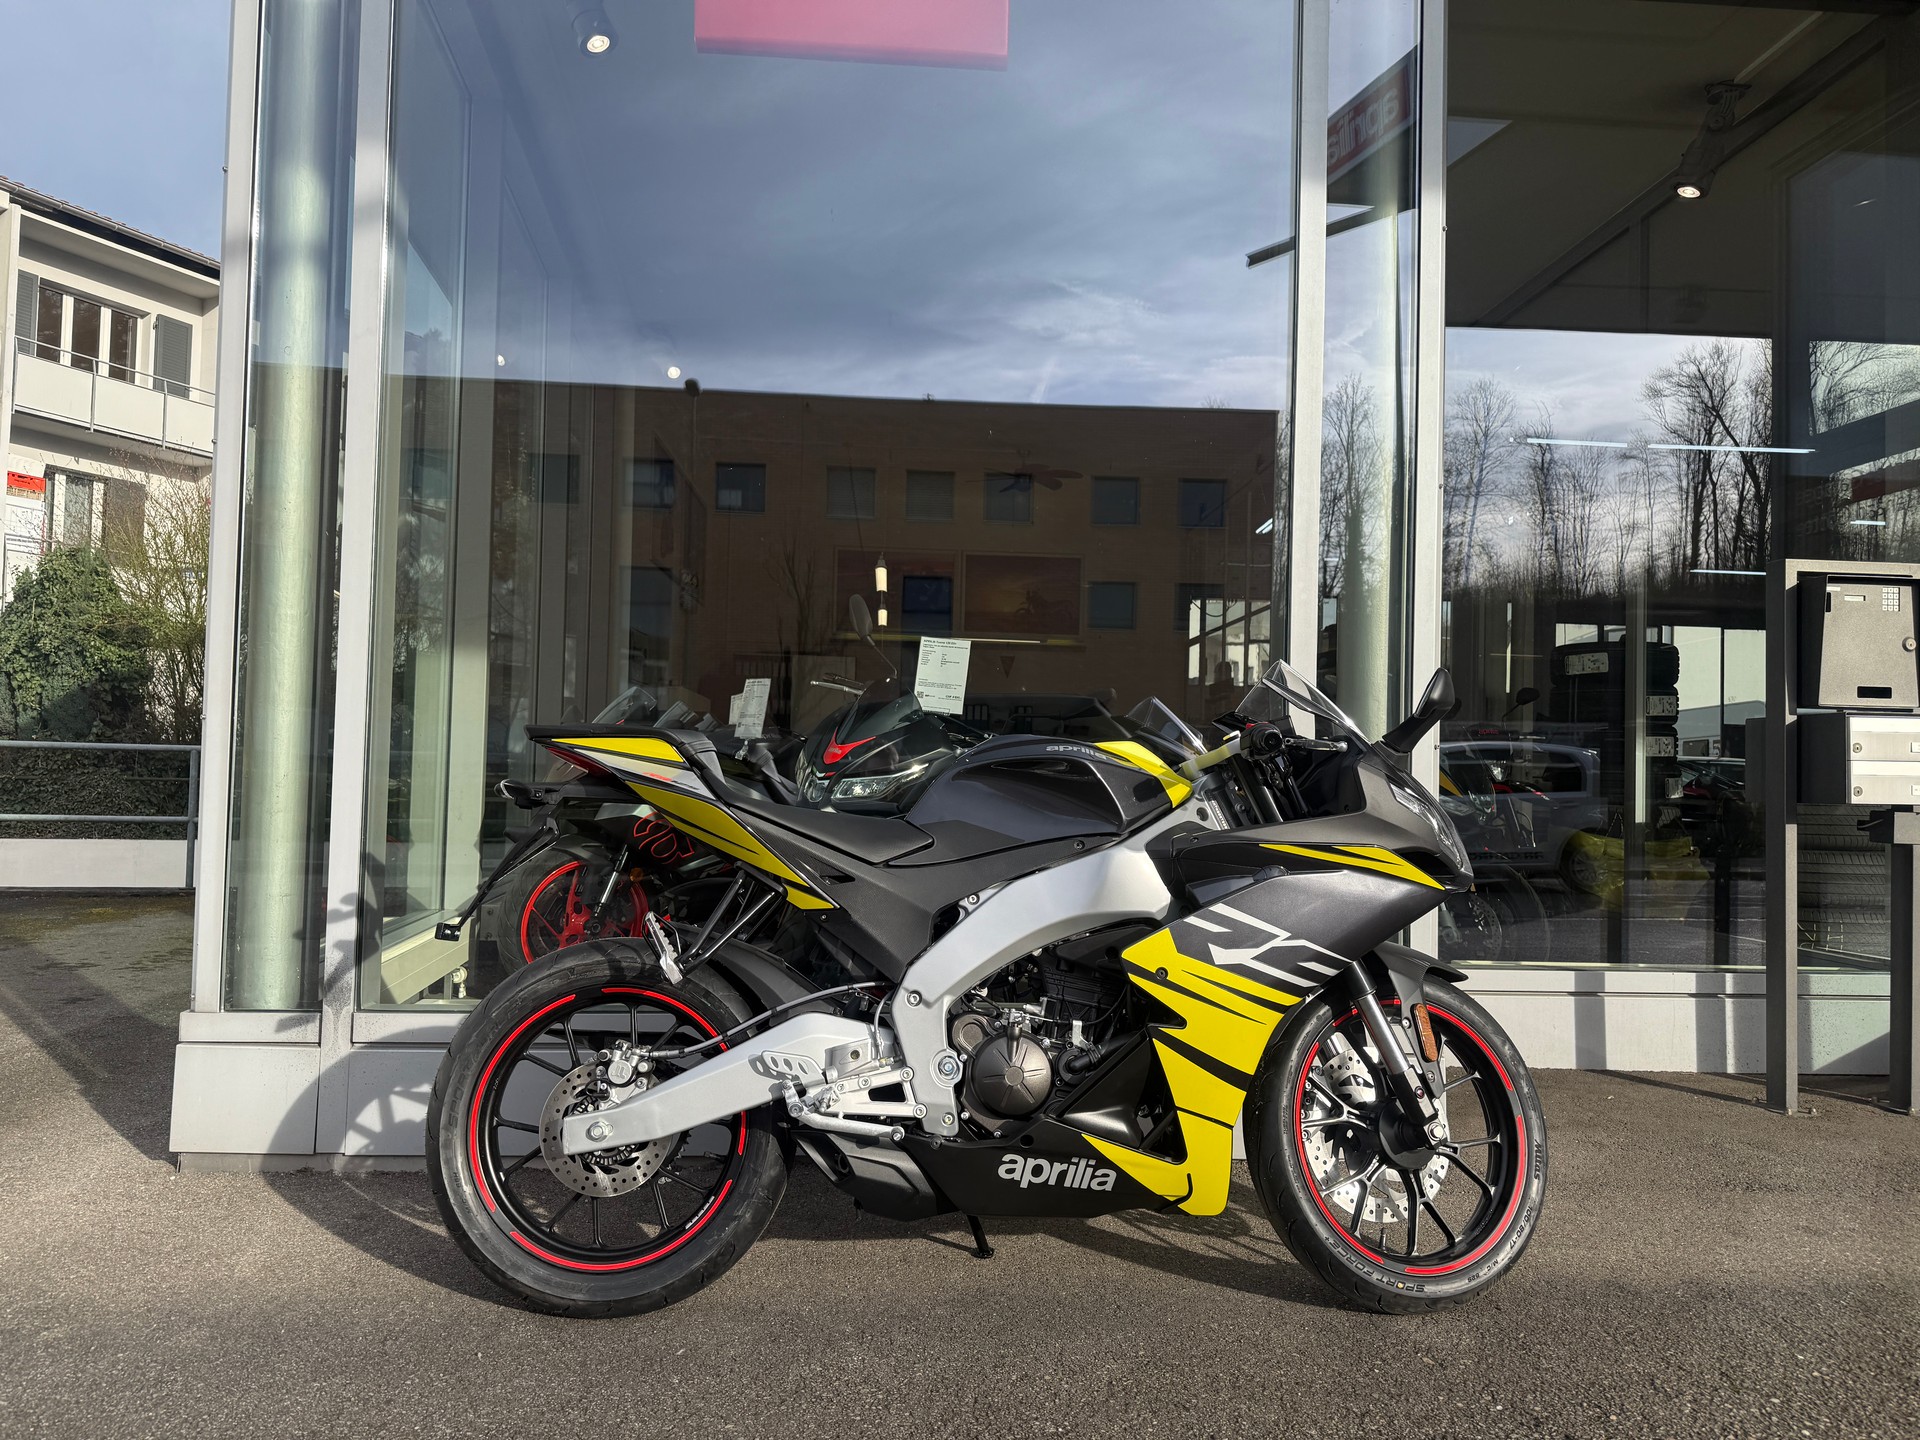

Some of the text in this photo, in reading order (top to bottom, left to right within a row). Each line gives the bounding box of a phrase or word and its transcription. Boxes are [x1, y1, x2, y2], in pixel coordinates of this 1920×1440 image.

[1046, 745, 1106, 760] aprilia
[997, 1153, 1117, 1192] aprilia
[1324, 1236, 1426, 1293] SPORT FORCE+
